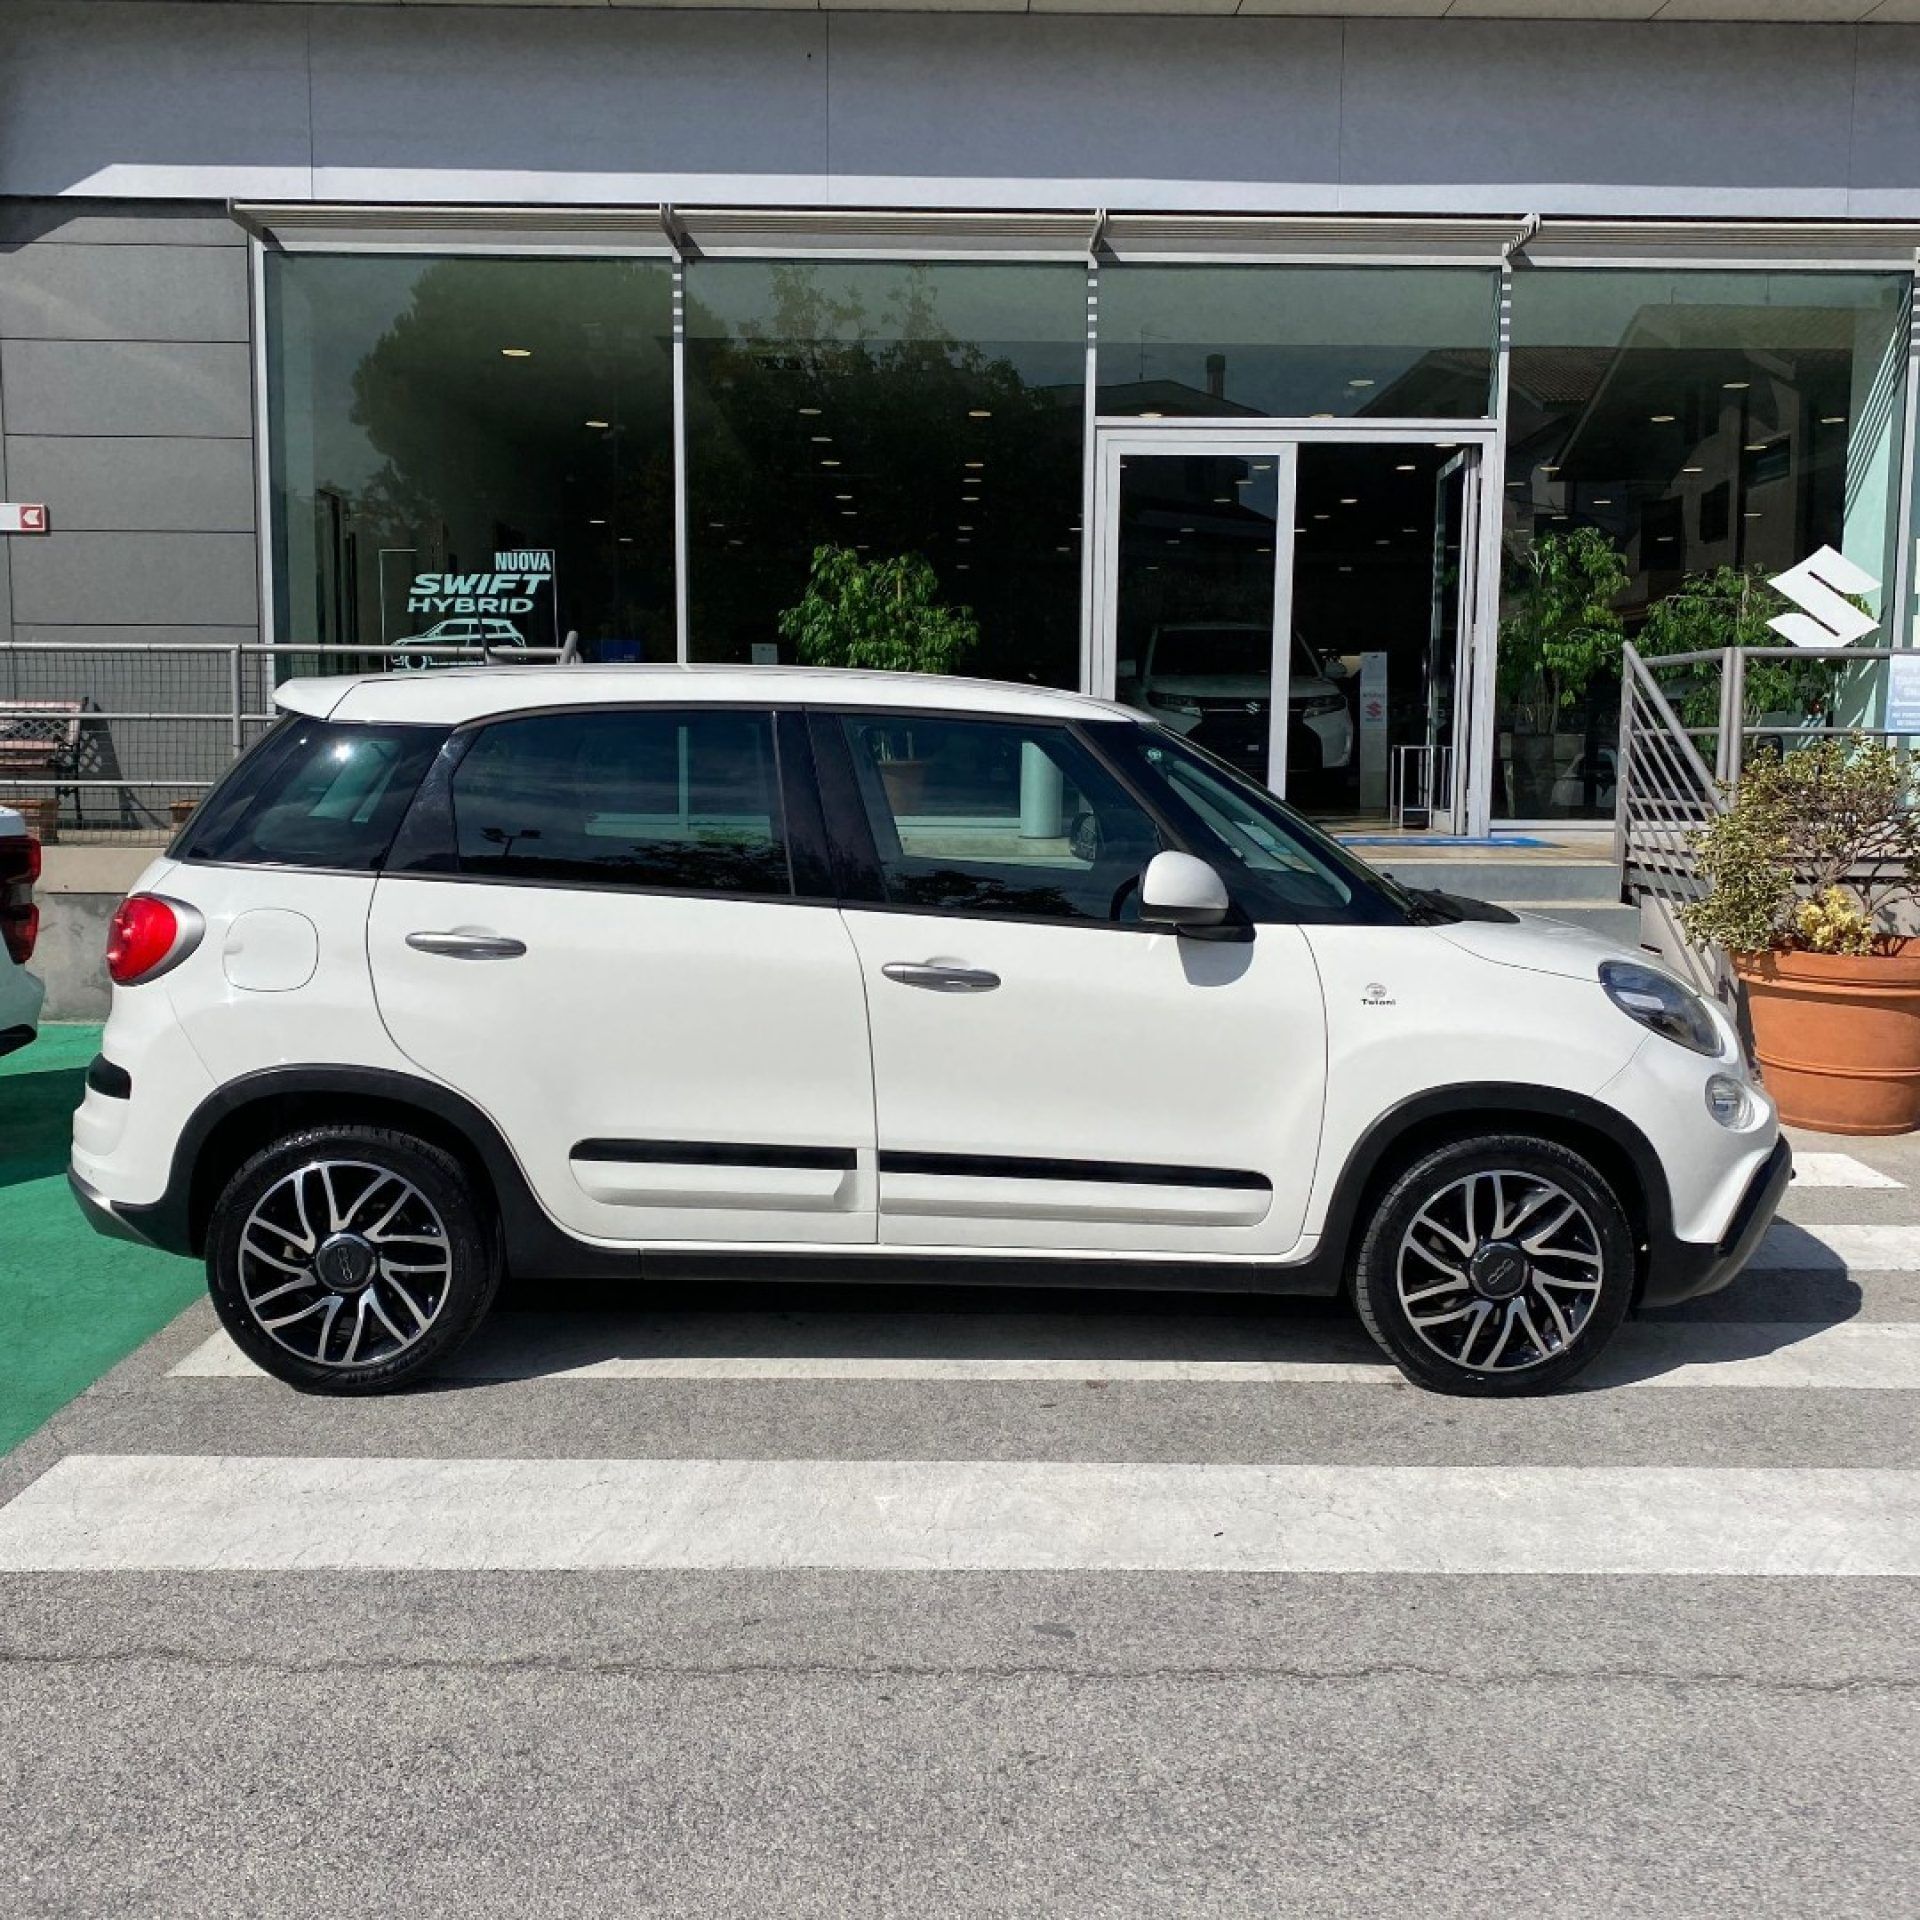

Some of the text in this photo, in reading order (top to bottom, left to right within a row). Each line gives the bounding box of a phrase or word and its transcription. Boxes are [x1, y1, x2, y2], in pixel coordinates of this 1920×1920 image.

[495, 552, 551, 571] NUOVA
[409, 573, 551, 595] SWIFT
[407, 597, 534, 613] HYBRID
